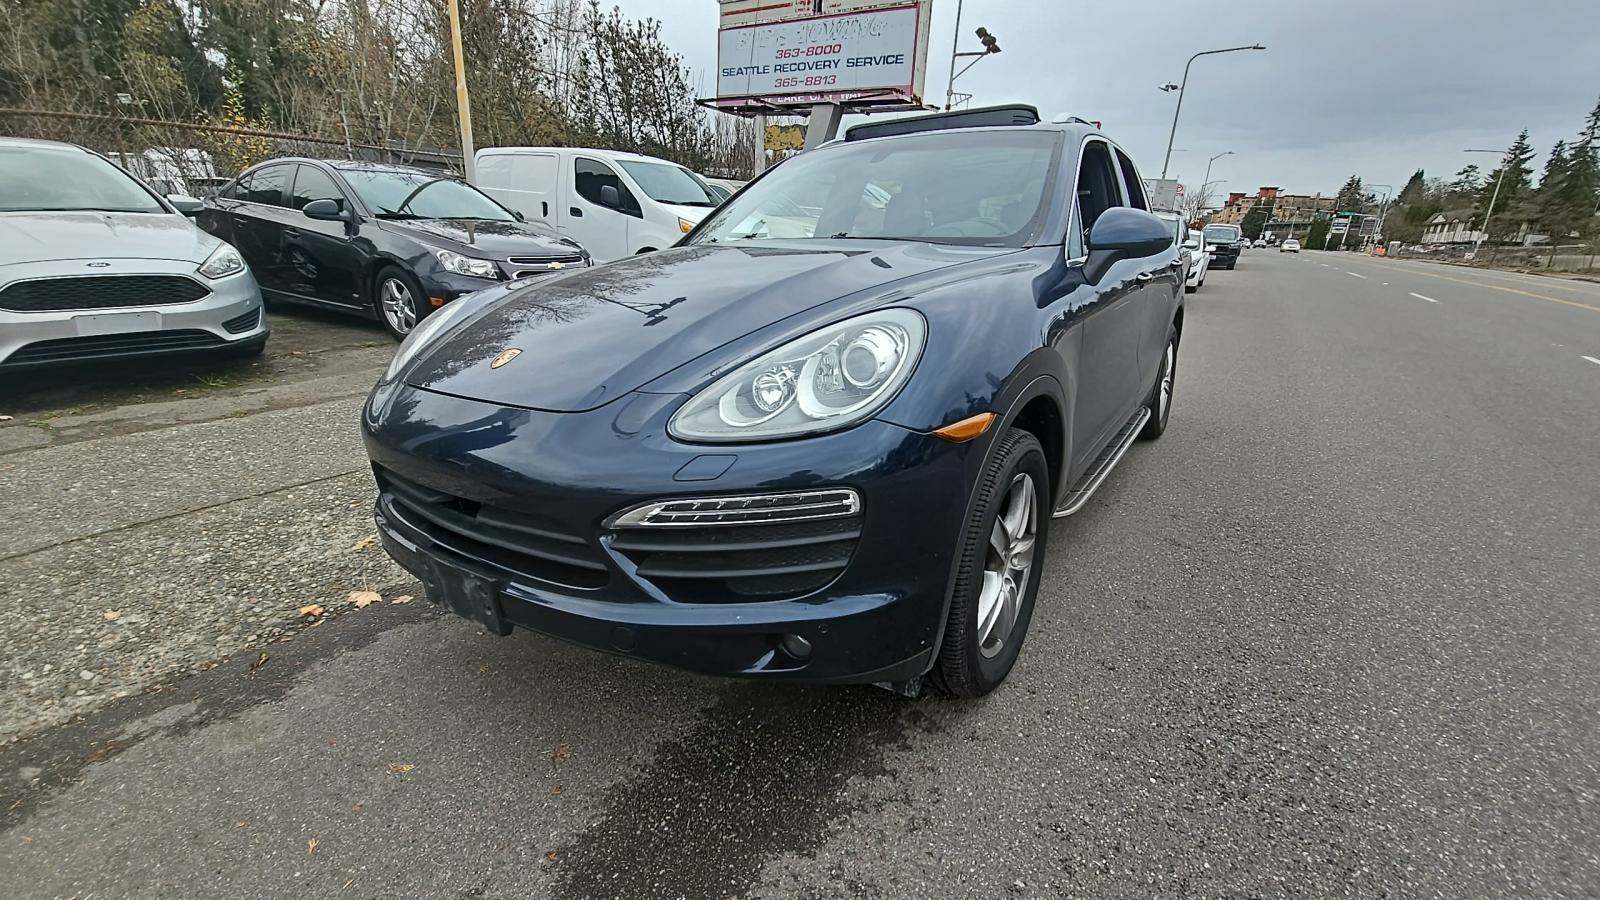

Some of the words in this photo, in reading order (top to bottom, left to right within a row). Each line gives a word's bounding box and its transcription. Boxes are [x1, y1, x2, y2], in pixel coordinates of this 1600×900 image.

[776, 44, 842, 60] 363-8000
[722, 66, 770, 77] SEATTLE
[774, 59, 841, 74] RECOVERY
[846, 54, 905, 68] SERVICE
[774, 75, 837, 89] 365-8813
